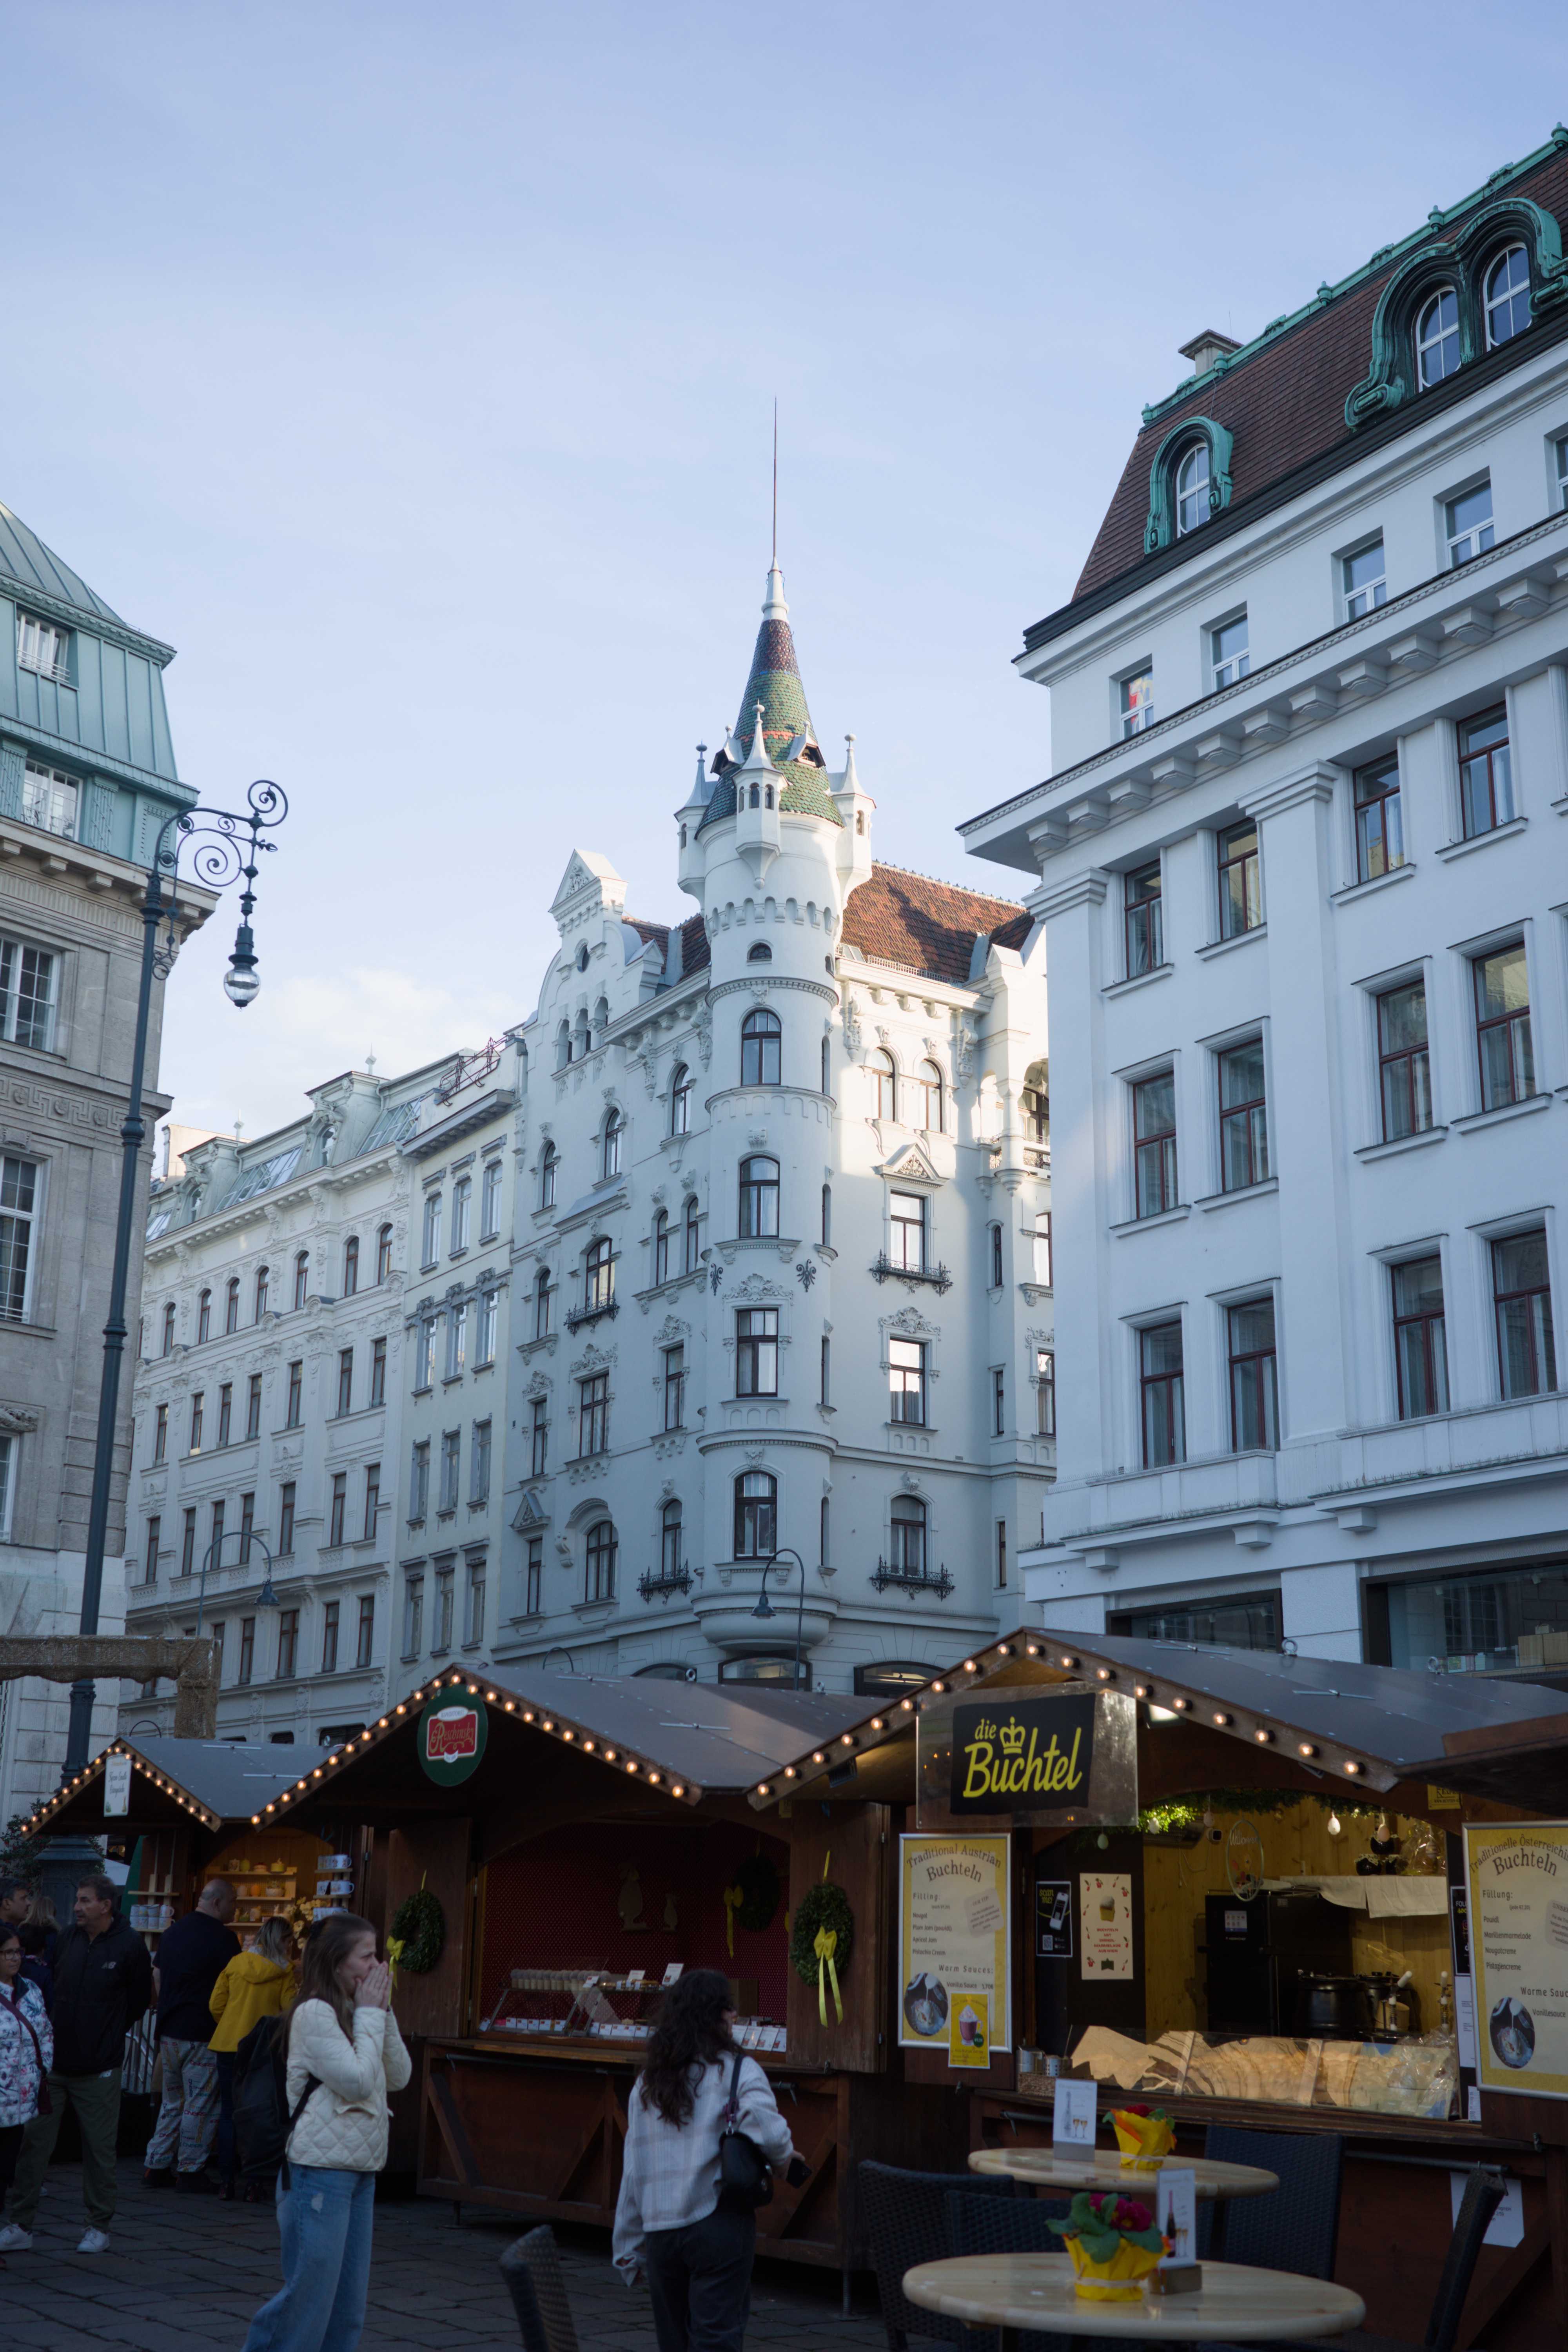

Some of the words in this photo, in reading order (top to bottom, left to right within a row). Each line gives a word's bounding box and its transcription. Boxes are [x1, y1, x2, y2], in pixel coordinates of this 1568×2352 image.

[975, 1719, 997, 1740] die
[963, 1727, 1082, 1797] Buchtel
[907, 1844, 957, 1868] Traditional
[961, 1845, 1001, 1868] Austrian
[1470, 1837, 1517, 1873] Traditionelle
[1493, 1848, 1557, 1876] Buchteln
[926, 1860, 982, 1882] Buchteln
[913, 1893, 940, 1901] Filling:
[1483, 1890, 1513, 1901] Füllung:
[1485, 1947, 1516, 1956] Nougatcreme
[963, 1965, 993, 1974] Sauces:
[1520, 1987, 1547, 1996] Warme
[1532, 2009, 1566, 2017] Vanillesauce
